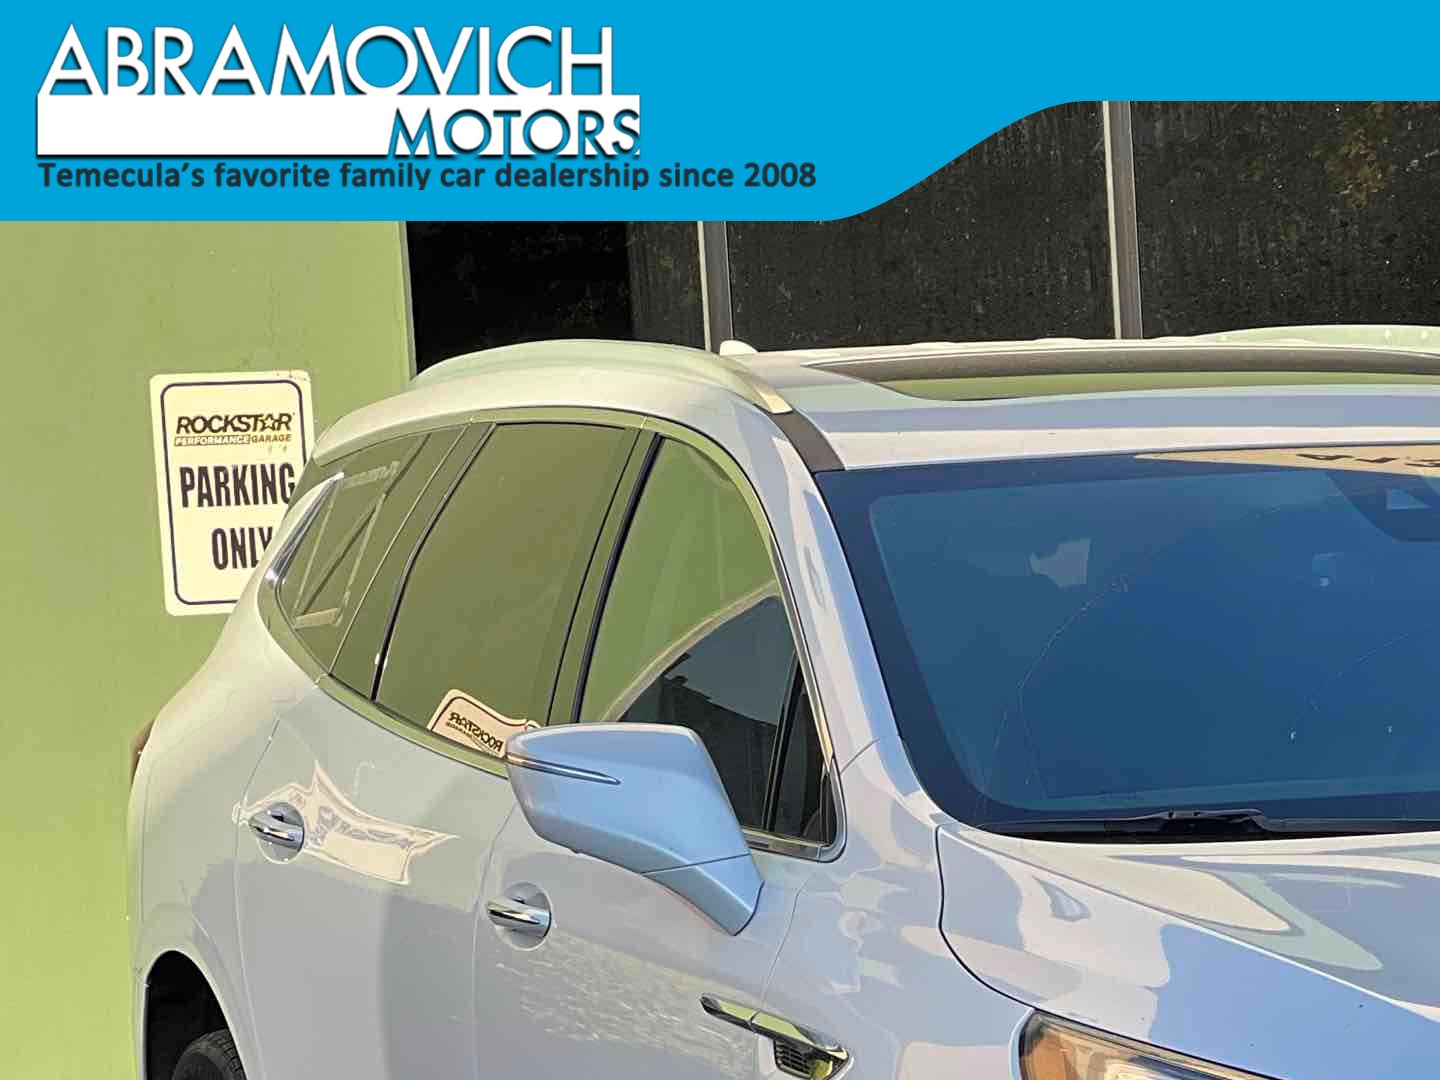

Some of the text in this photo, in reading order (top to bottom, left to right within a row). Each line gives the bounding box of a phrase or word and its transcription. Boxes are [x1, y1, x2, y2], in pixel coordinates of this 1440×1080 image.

[176, 412, 292, 434] ROCKSTAR
[174, 433, 292, 446] PERFORMANCE GARAGE
[179, 462, 296, 508] PARKING
